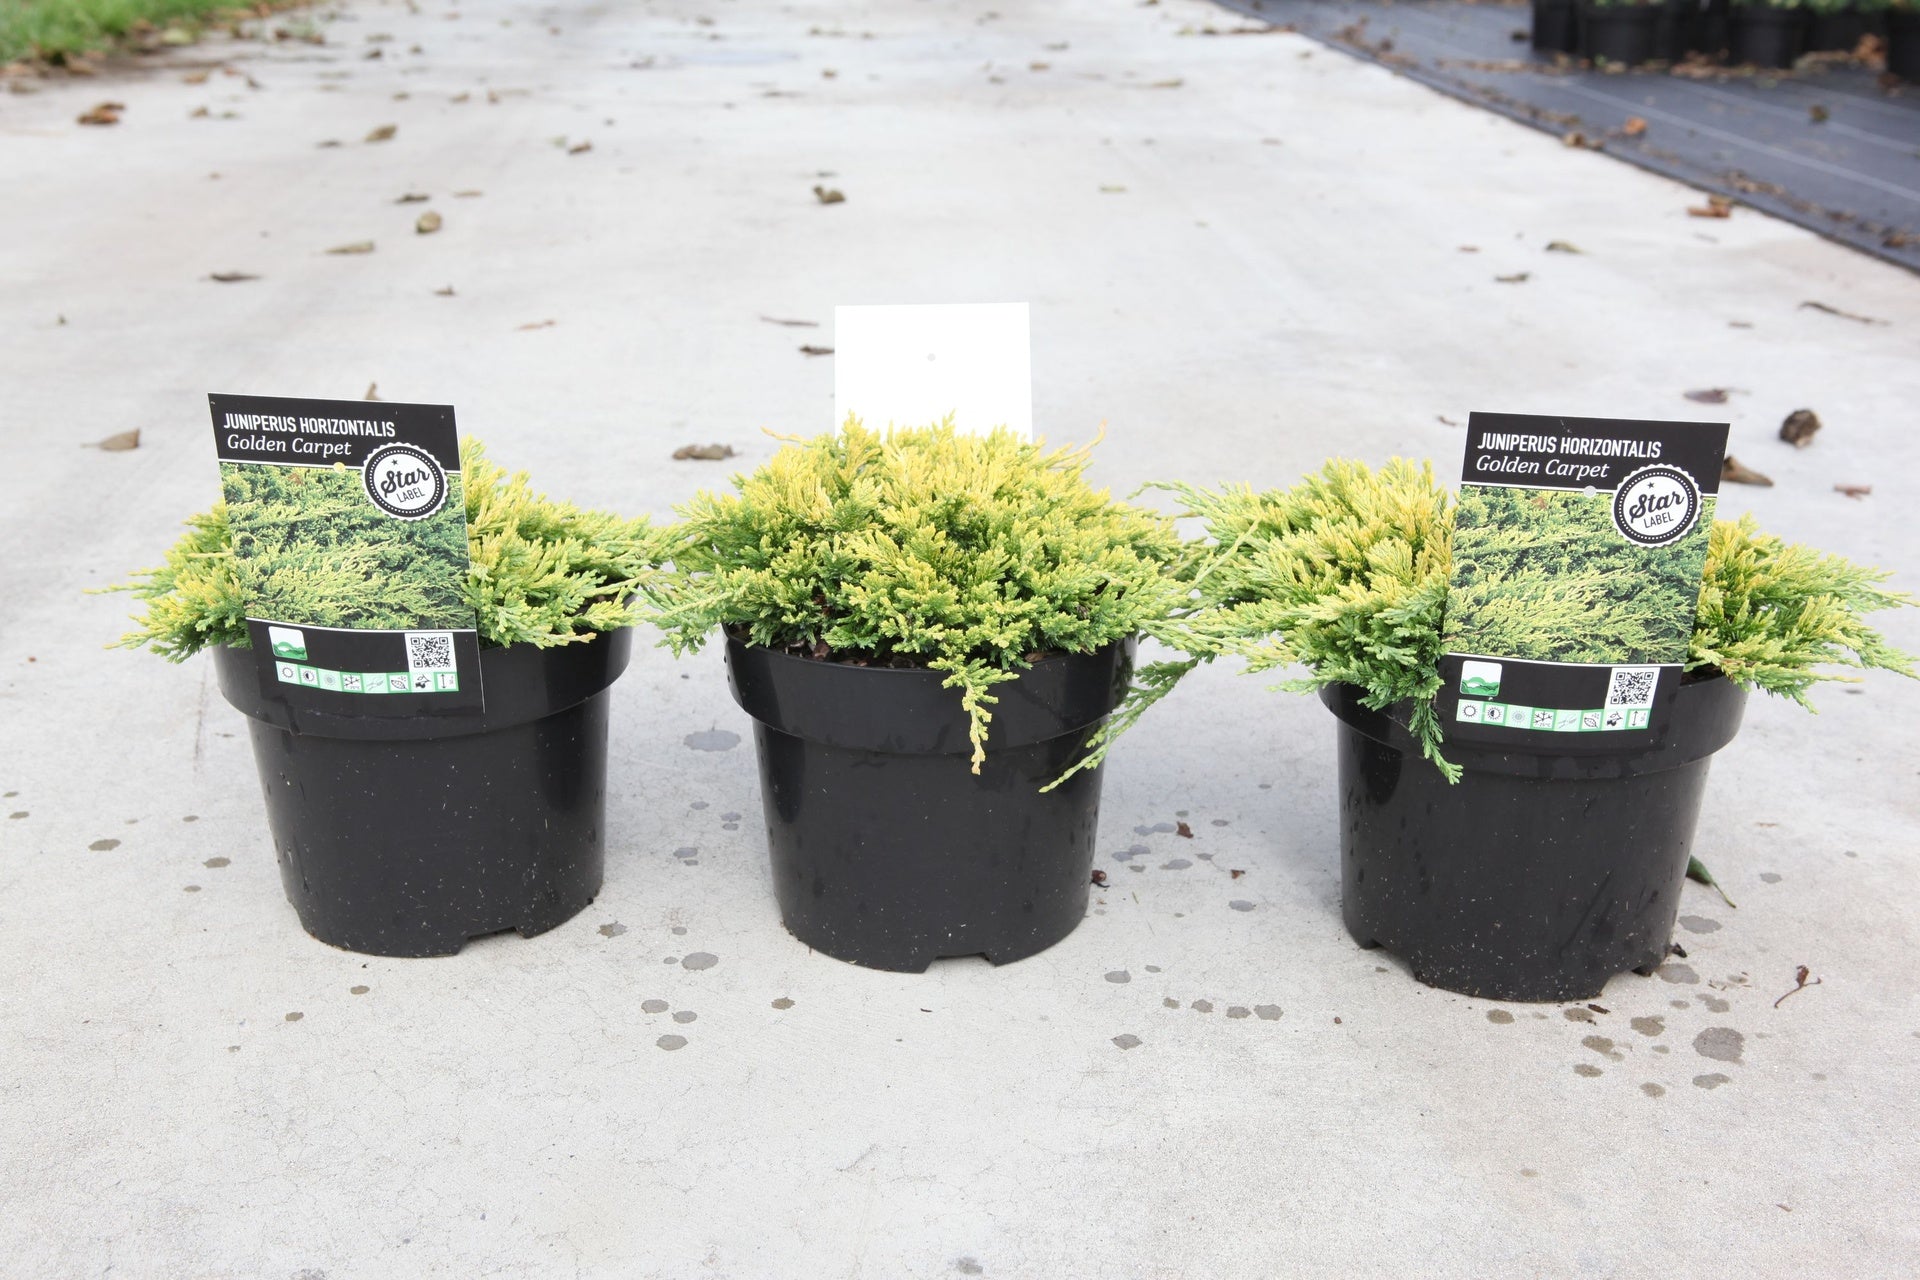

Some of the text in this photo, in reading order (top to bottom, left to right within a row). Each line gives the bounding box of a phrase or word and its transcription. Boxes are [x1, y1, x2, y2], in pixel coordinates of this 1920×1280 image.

[224, 413, 396, 437] JUNIPERUS HORIZONTALIS
[227, 434, 352, 458] Golden Carpet
[1477, 432, 1661, 458] JUNIPERUS HORIZONTALIS
[1476, 455, 1610, 481] Golden Carpet
[380, 467, 430, 497] Star
[396, 487, 425, 503] LABEL
[1629, 491, 1685, 523] Star
[1643, 511, 1674, 529] LABEL
